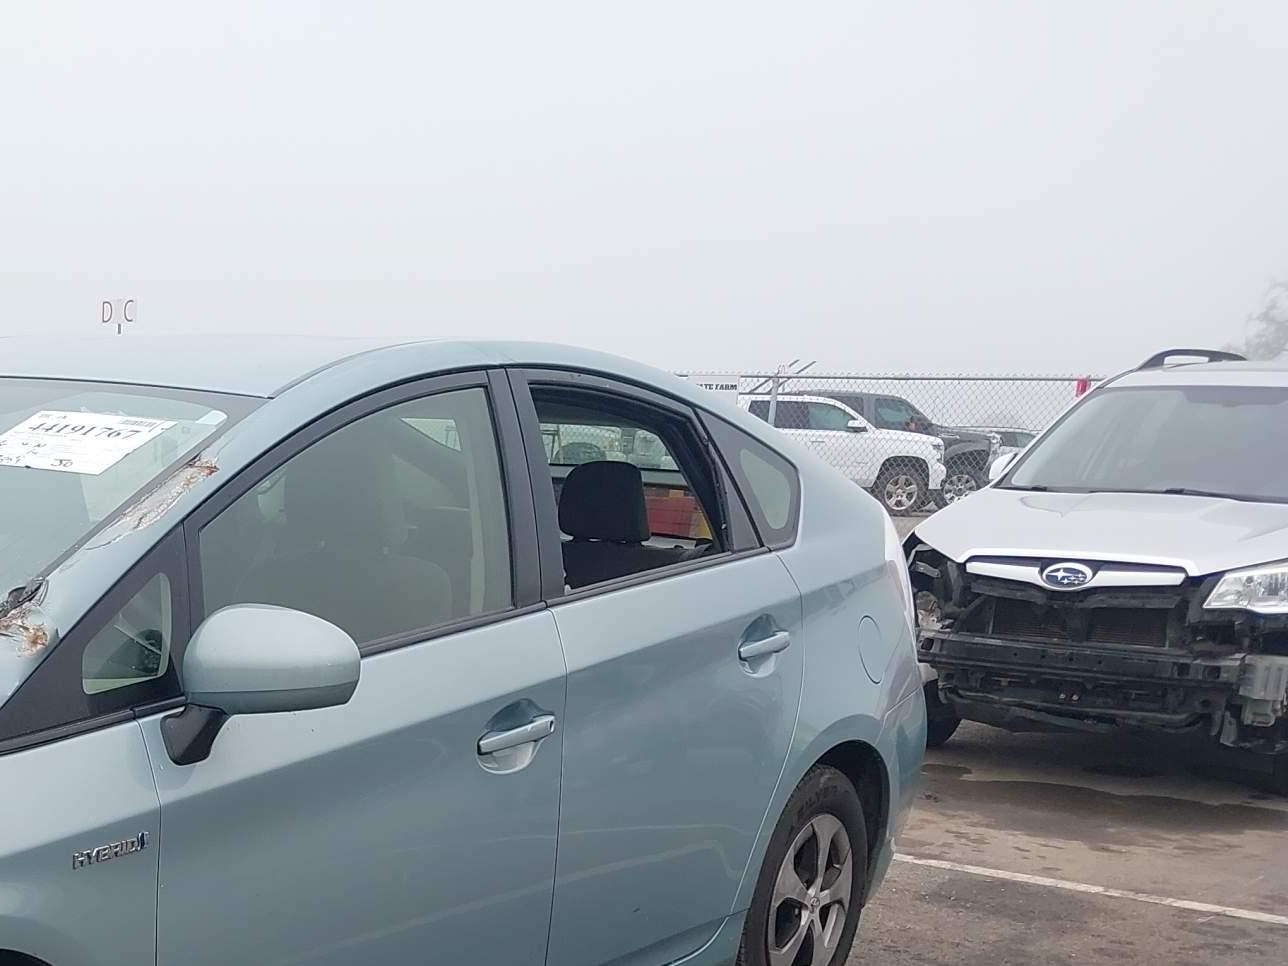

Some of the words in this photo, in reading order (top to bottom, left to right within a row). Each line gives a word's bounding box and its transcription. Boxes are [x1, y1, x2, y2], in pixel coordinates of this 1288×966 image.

[102, 301, 113, 323] D
[124, 299, 134, 322] C
[28, 422, 142, 439] 44191767
[72, 838, 138, 870] HYBRID
